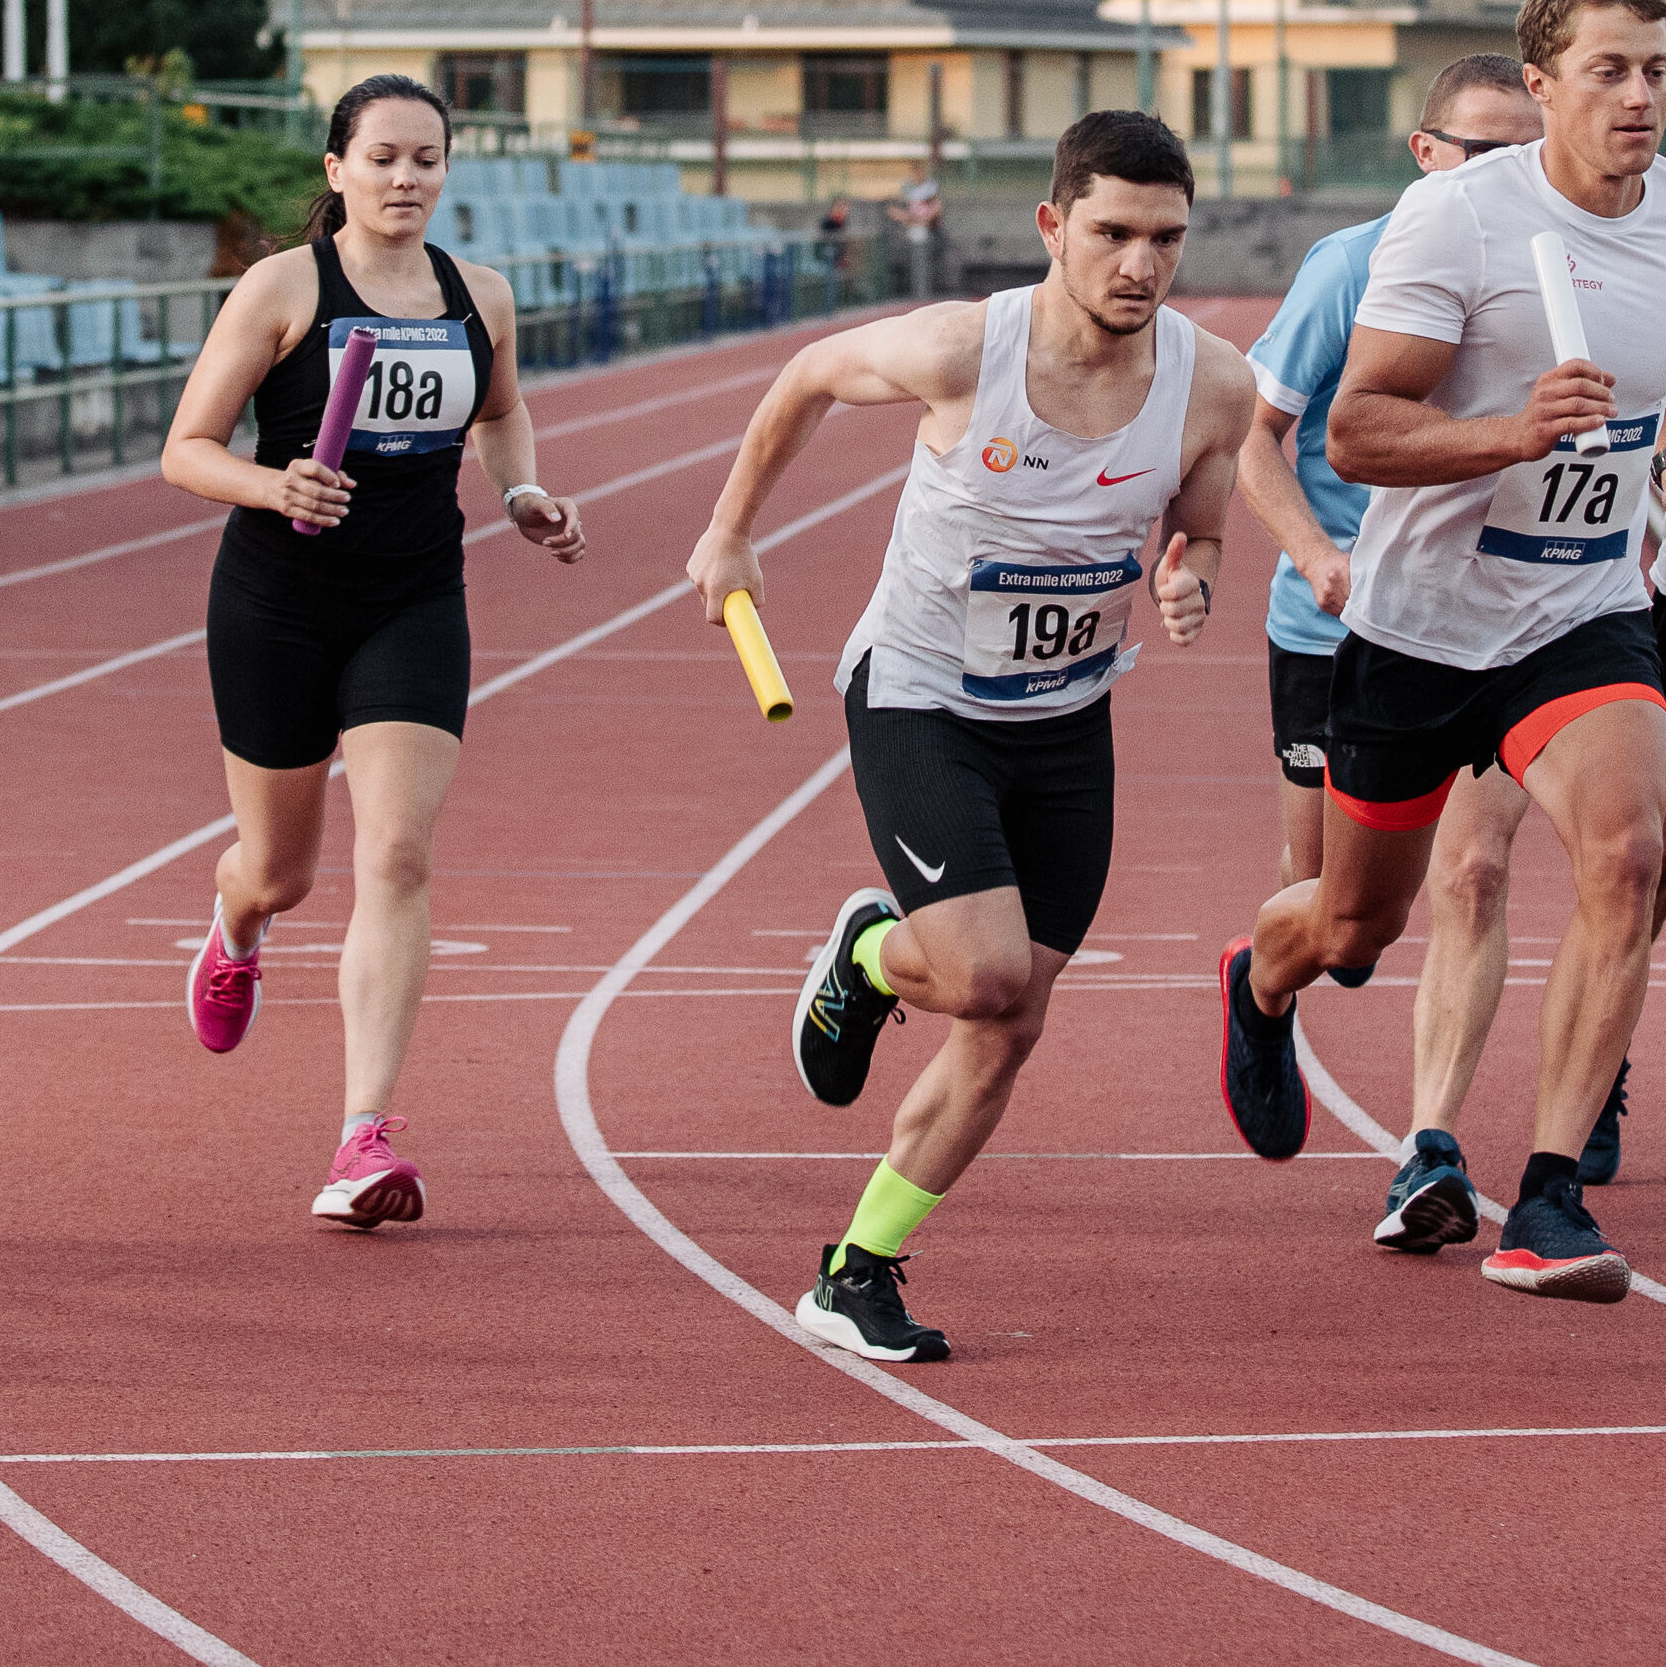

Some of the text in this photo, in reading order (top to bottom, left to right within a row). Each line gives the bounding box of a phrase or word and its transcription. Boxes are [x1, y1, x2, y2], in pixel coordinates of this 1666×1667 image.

[382, 326, 401, 341] mile
[400, 327, 426, 342] KPMG
[425, 327, 449, 343] 2022
[364, 360, 443, 421] 18a
[1607, 425, 1644, 443] MG 2022
[375, 439, 413, 452] KPMG
[1022, 455, 1050, 471] NN
[1538, 462, 1619, 525] 17a
[1540, 547, 1583, 560] KPMG
[998, 569, 1124, 587] Extra mile KPMG 2022
[1008, 602, 1101, 662] 19a
[1025, 675, 1067, 694] KPMG
